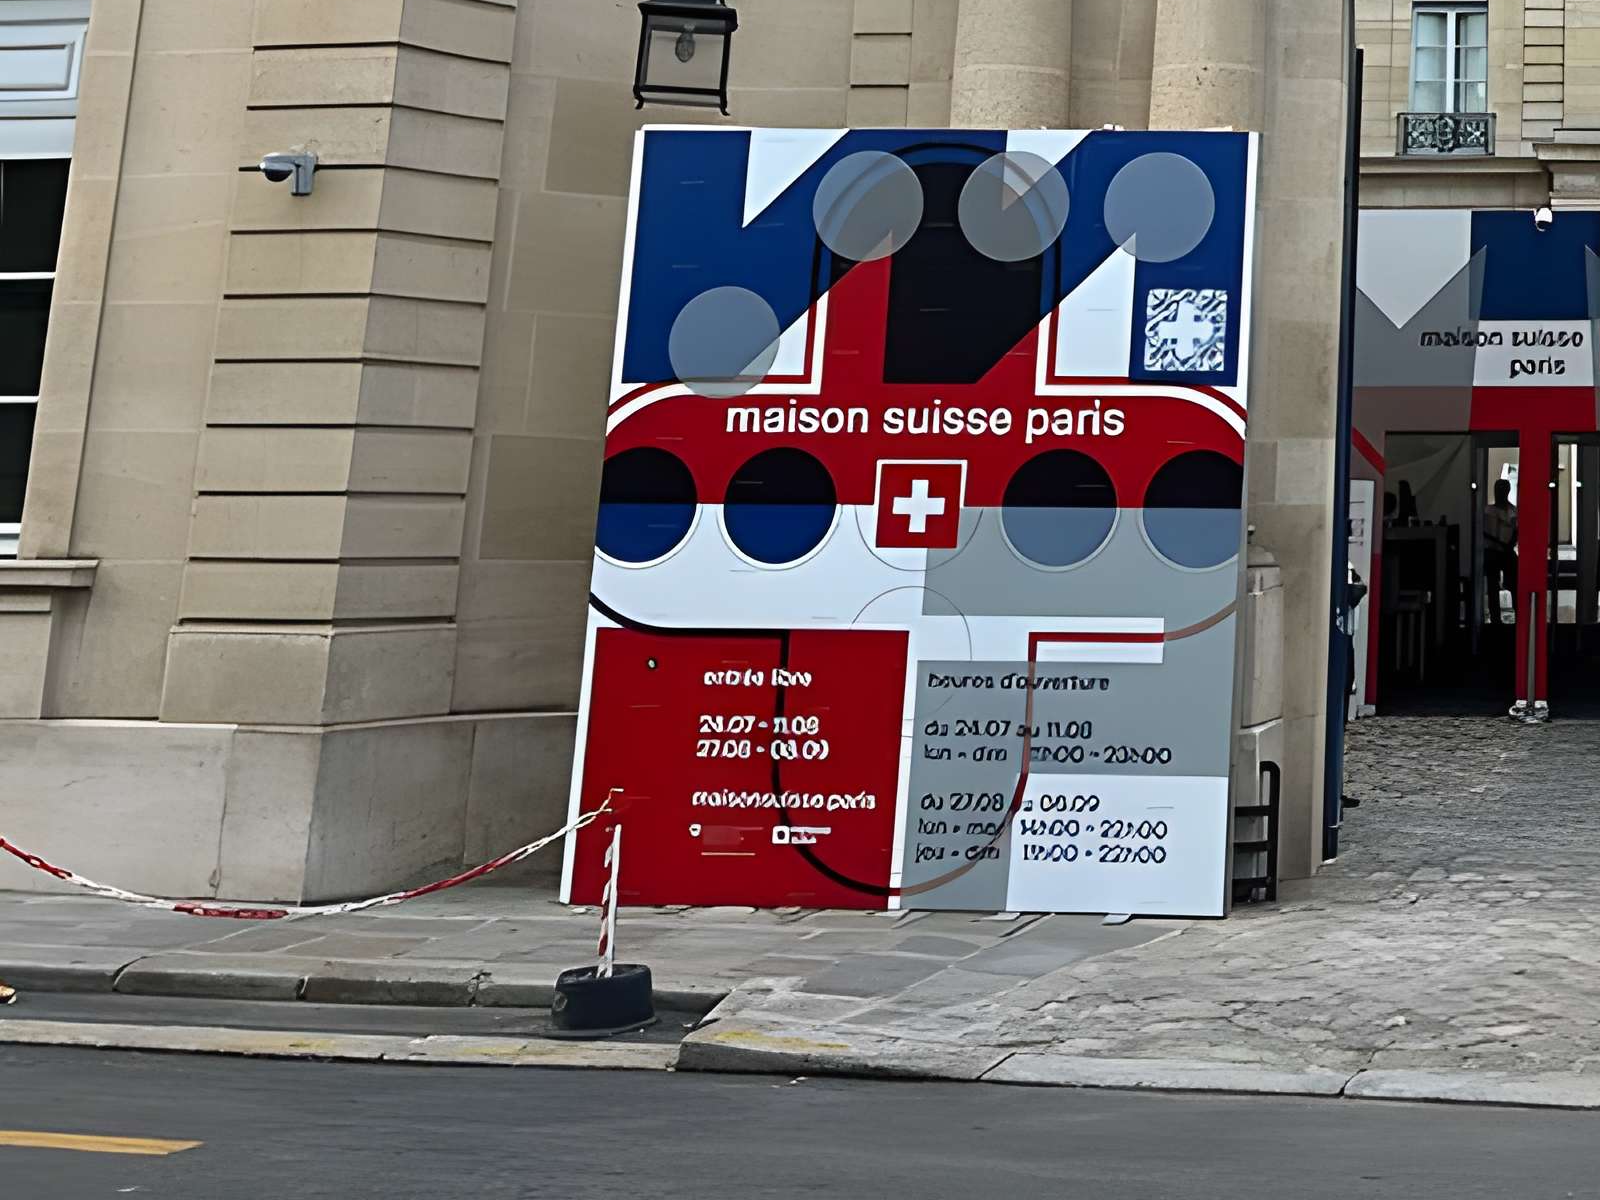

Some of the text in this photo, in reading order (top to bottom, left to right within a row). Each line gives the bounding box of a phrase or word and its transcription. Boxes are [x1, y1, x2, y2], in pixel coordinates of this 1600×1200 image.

[726, 398, 1126, 444] maison suisse paris
